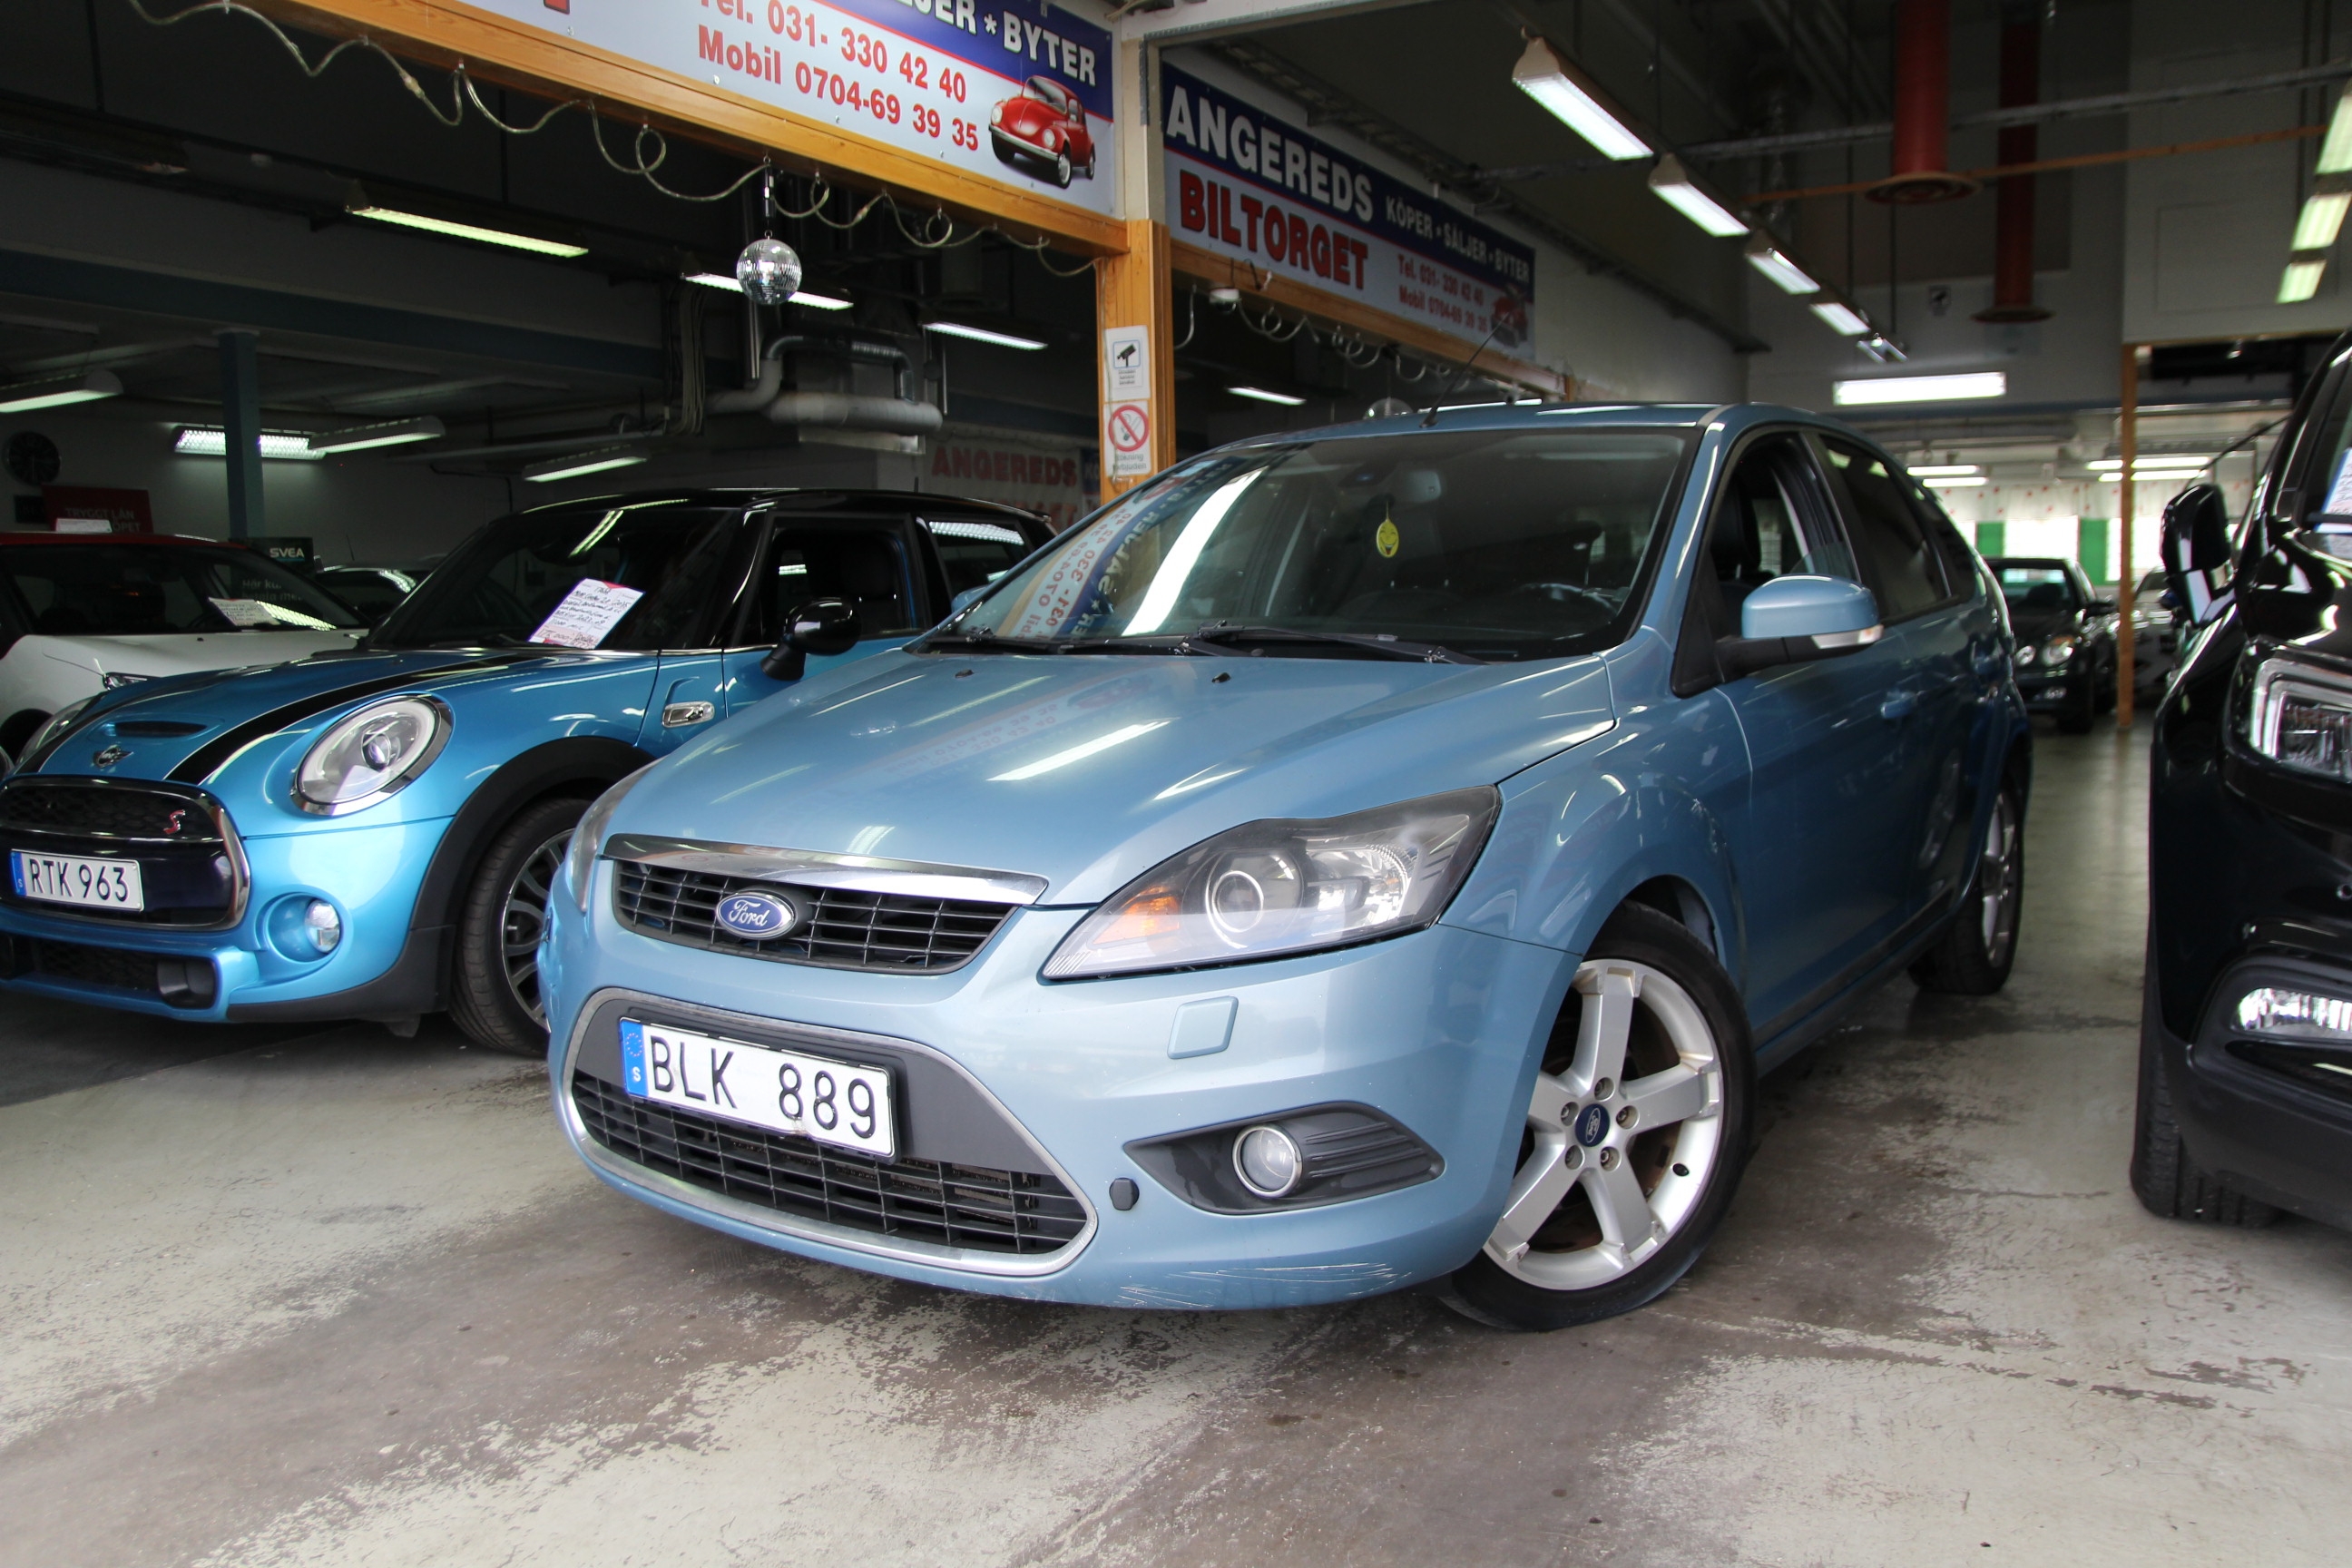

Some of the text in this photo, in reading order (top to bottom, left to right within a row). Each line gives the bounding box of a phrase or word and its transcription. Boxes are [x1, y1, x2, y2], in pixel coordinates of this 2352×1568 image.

[701, 0, 966, 103] el. 031- 330 42 40
[1003, 10, 1097, 88] BYTER
[699, 24, 979, 151] Mobil 0704-69 39 35
[1166, 84, 1374, 222] ANGEREDS
[1180, 169, 1369, 290] BILTORGET
[1385, 194, 1434, 240] KÖPER
[931, 446, 1079, 488] ANGEREDS
[1115, 452, 1144, 461] ökning
[269, 547, 305, 558] SVEA
[163, 809, 186, 835] S
[29, 858, 129, 902] RTK 963
[728, 898, 770, 927] Ford
[632, 1066, 642, 1083] S
[649, 1034, 877, 1140] BLK 889
